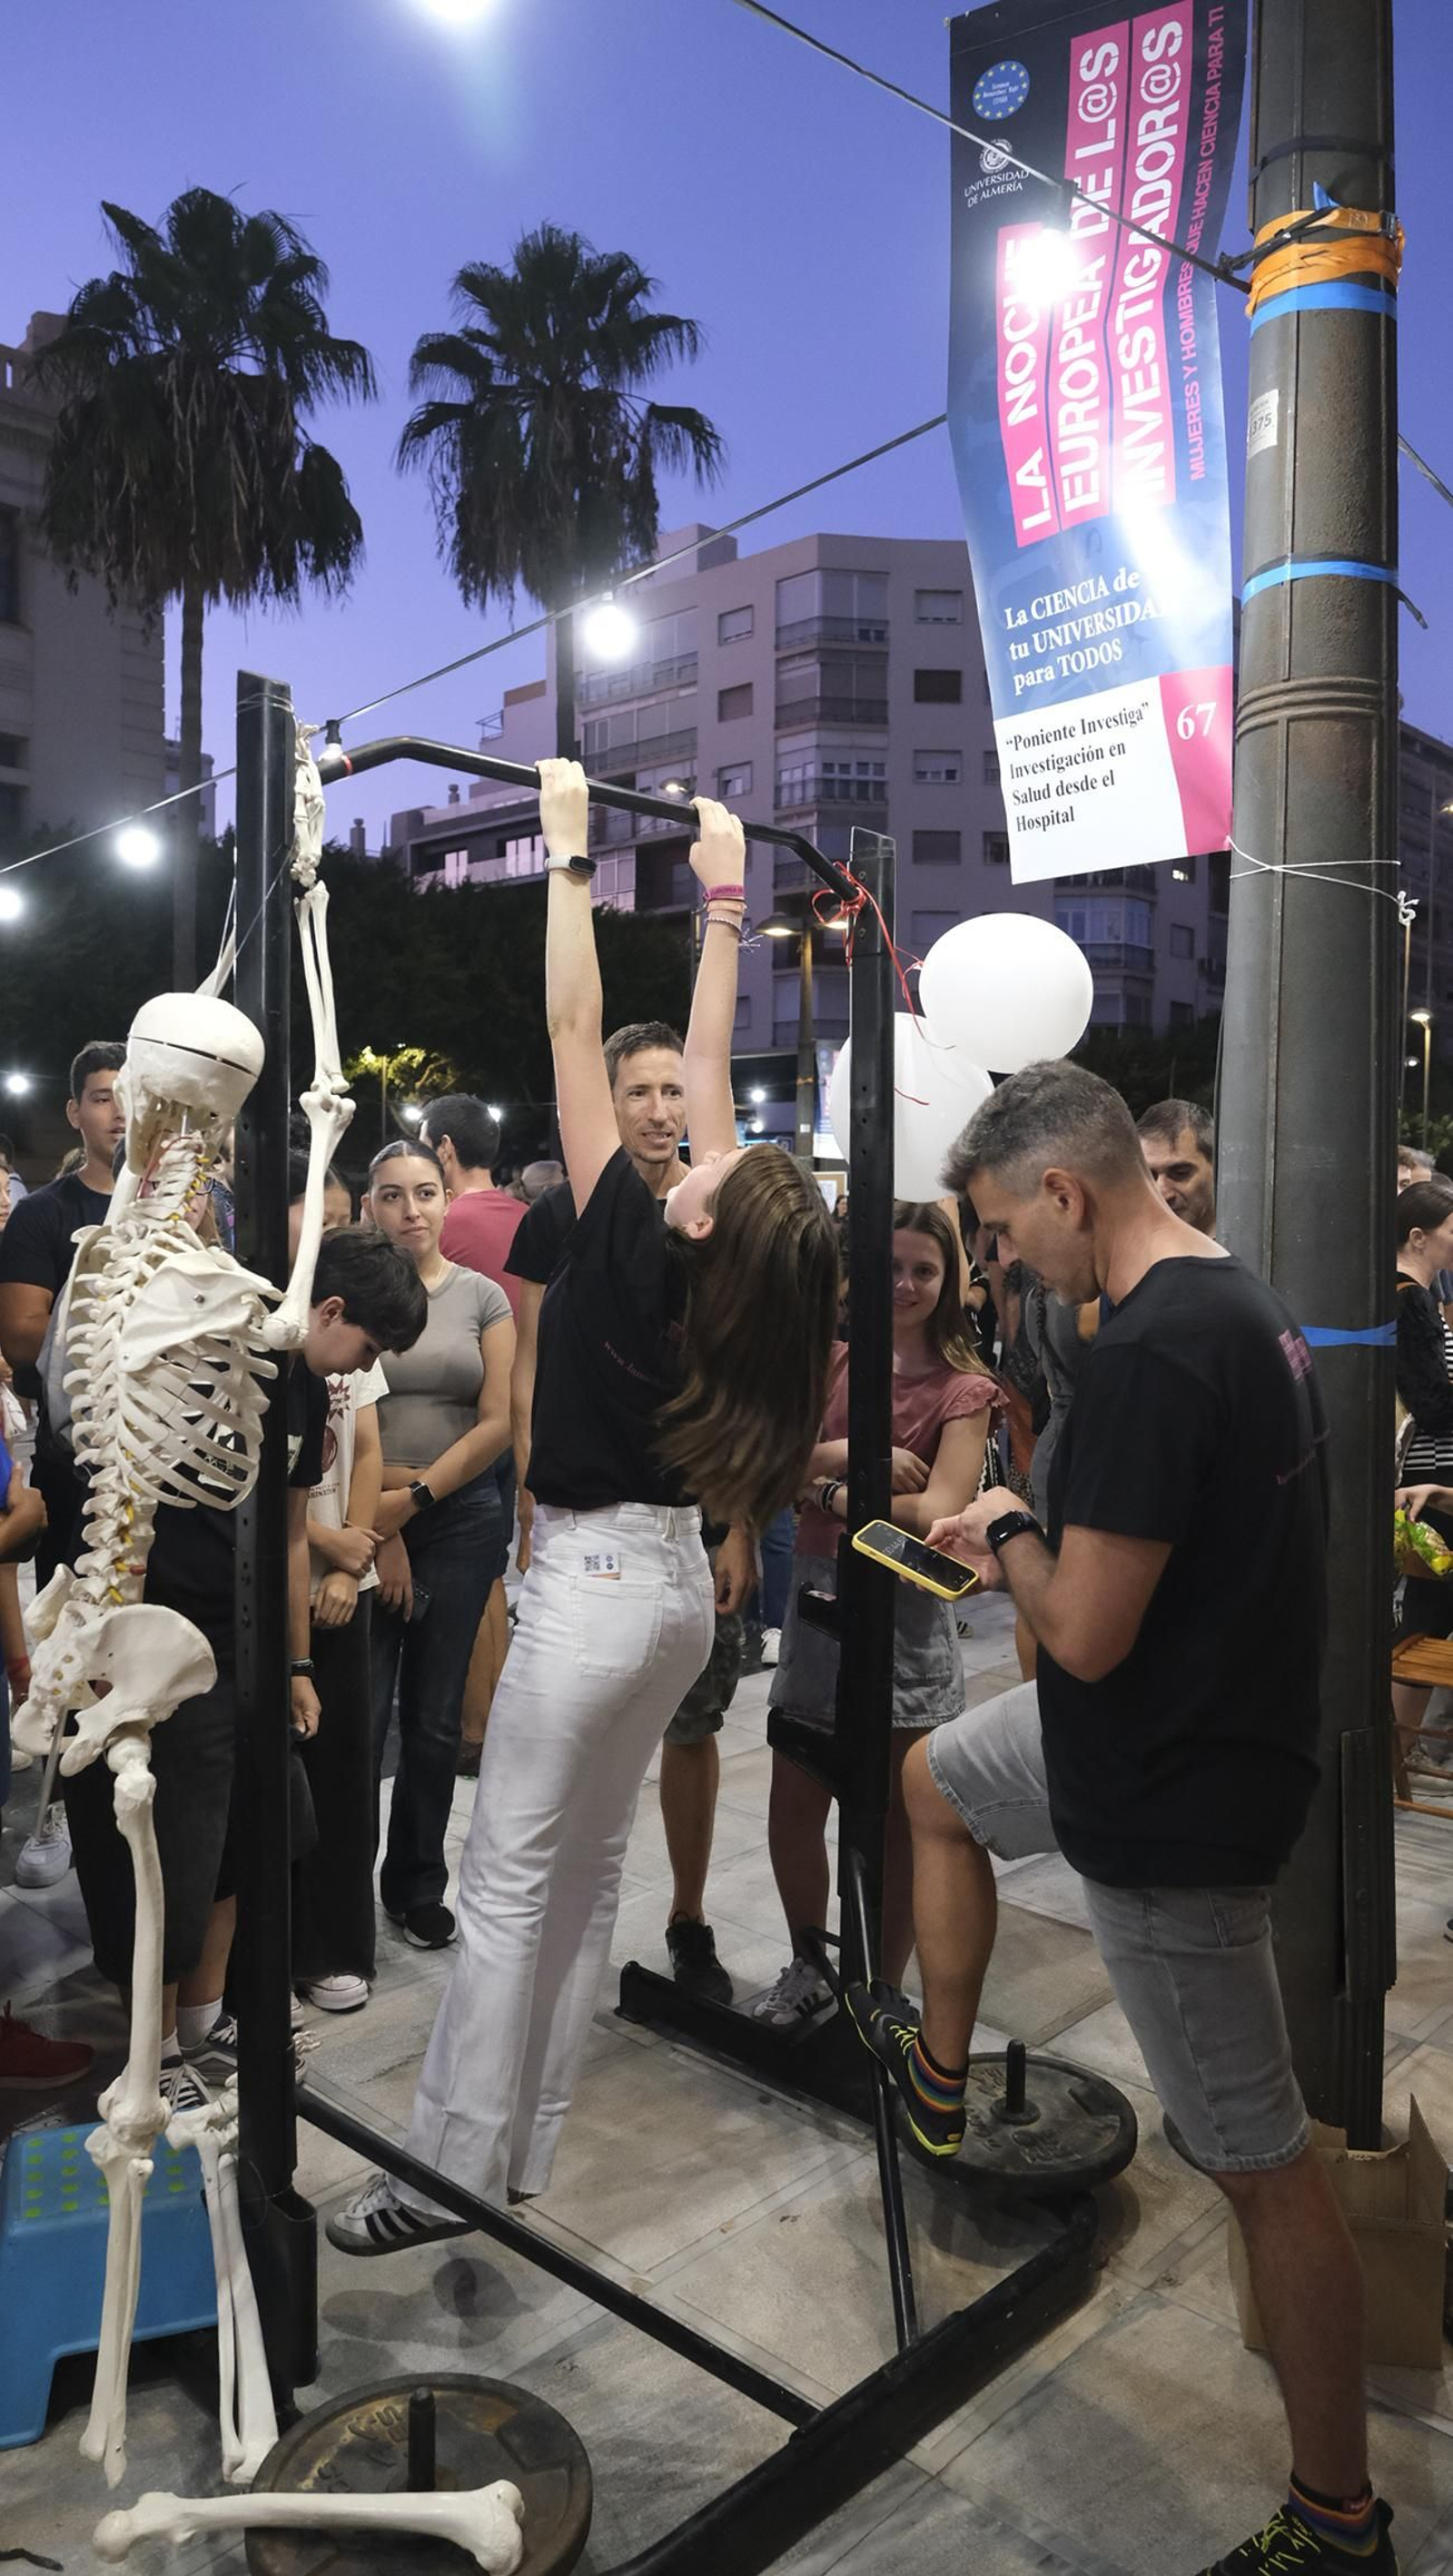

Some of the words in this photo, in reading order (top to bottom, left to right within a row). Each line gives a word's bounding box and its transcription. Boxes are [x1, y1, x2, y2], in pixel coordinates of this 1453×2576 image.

[1208, 5, 1224, 27] TI
[1207, 26, 1224, 81] PARA
[1077, 42, 1120, 159] L@S
[1200, 83, 1221, 157] CIENCIA
[964, 169, 1029, 197] UNIVERSIDAD
[967, 197, 979, 208] DE
[981, 181, 1023, 201] ALMERÍA
[1070, 168, 1113, 241] DE
[1191, 158, 1214, 221] HACEN
[1115, 21, 1182, 496] INVESTIGADOR@S
[1184, 219, 1204, 255] QUE
[1177, 261, 1197, 360] HOMBRES
[1057, 255, 1107, 512] EUROPEA
[1182, 365, 1198, 380] Y
[1184, 382, 1206, 480] MUJERES
[1015, 447, 1052, 530] LA
[1004, 607, 1028, 630] La
[1031, 575, 1107, 620] CIENCIA
[1113, 566, 1141, 593] de
[1009, 641, 1030, 661] tu
[1032, 595, 1168, 654] UNIVERSIDA
[1013, 663, 1055, 696] para
[1057, 638, 1123, 677] TODOS
[1177, 702, 1217, 740] 67
[1010, 745, 1105, 780] Investigación
[1109, 741, 1126, 758] en
[1013, 784, 1051, 806] Salud
[1055, 774, 1098, 797] desde
[1102, 768, 1115, 788] el
[1015, 805, 1075, 833] Hospital
